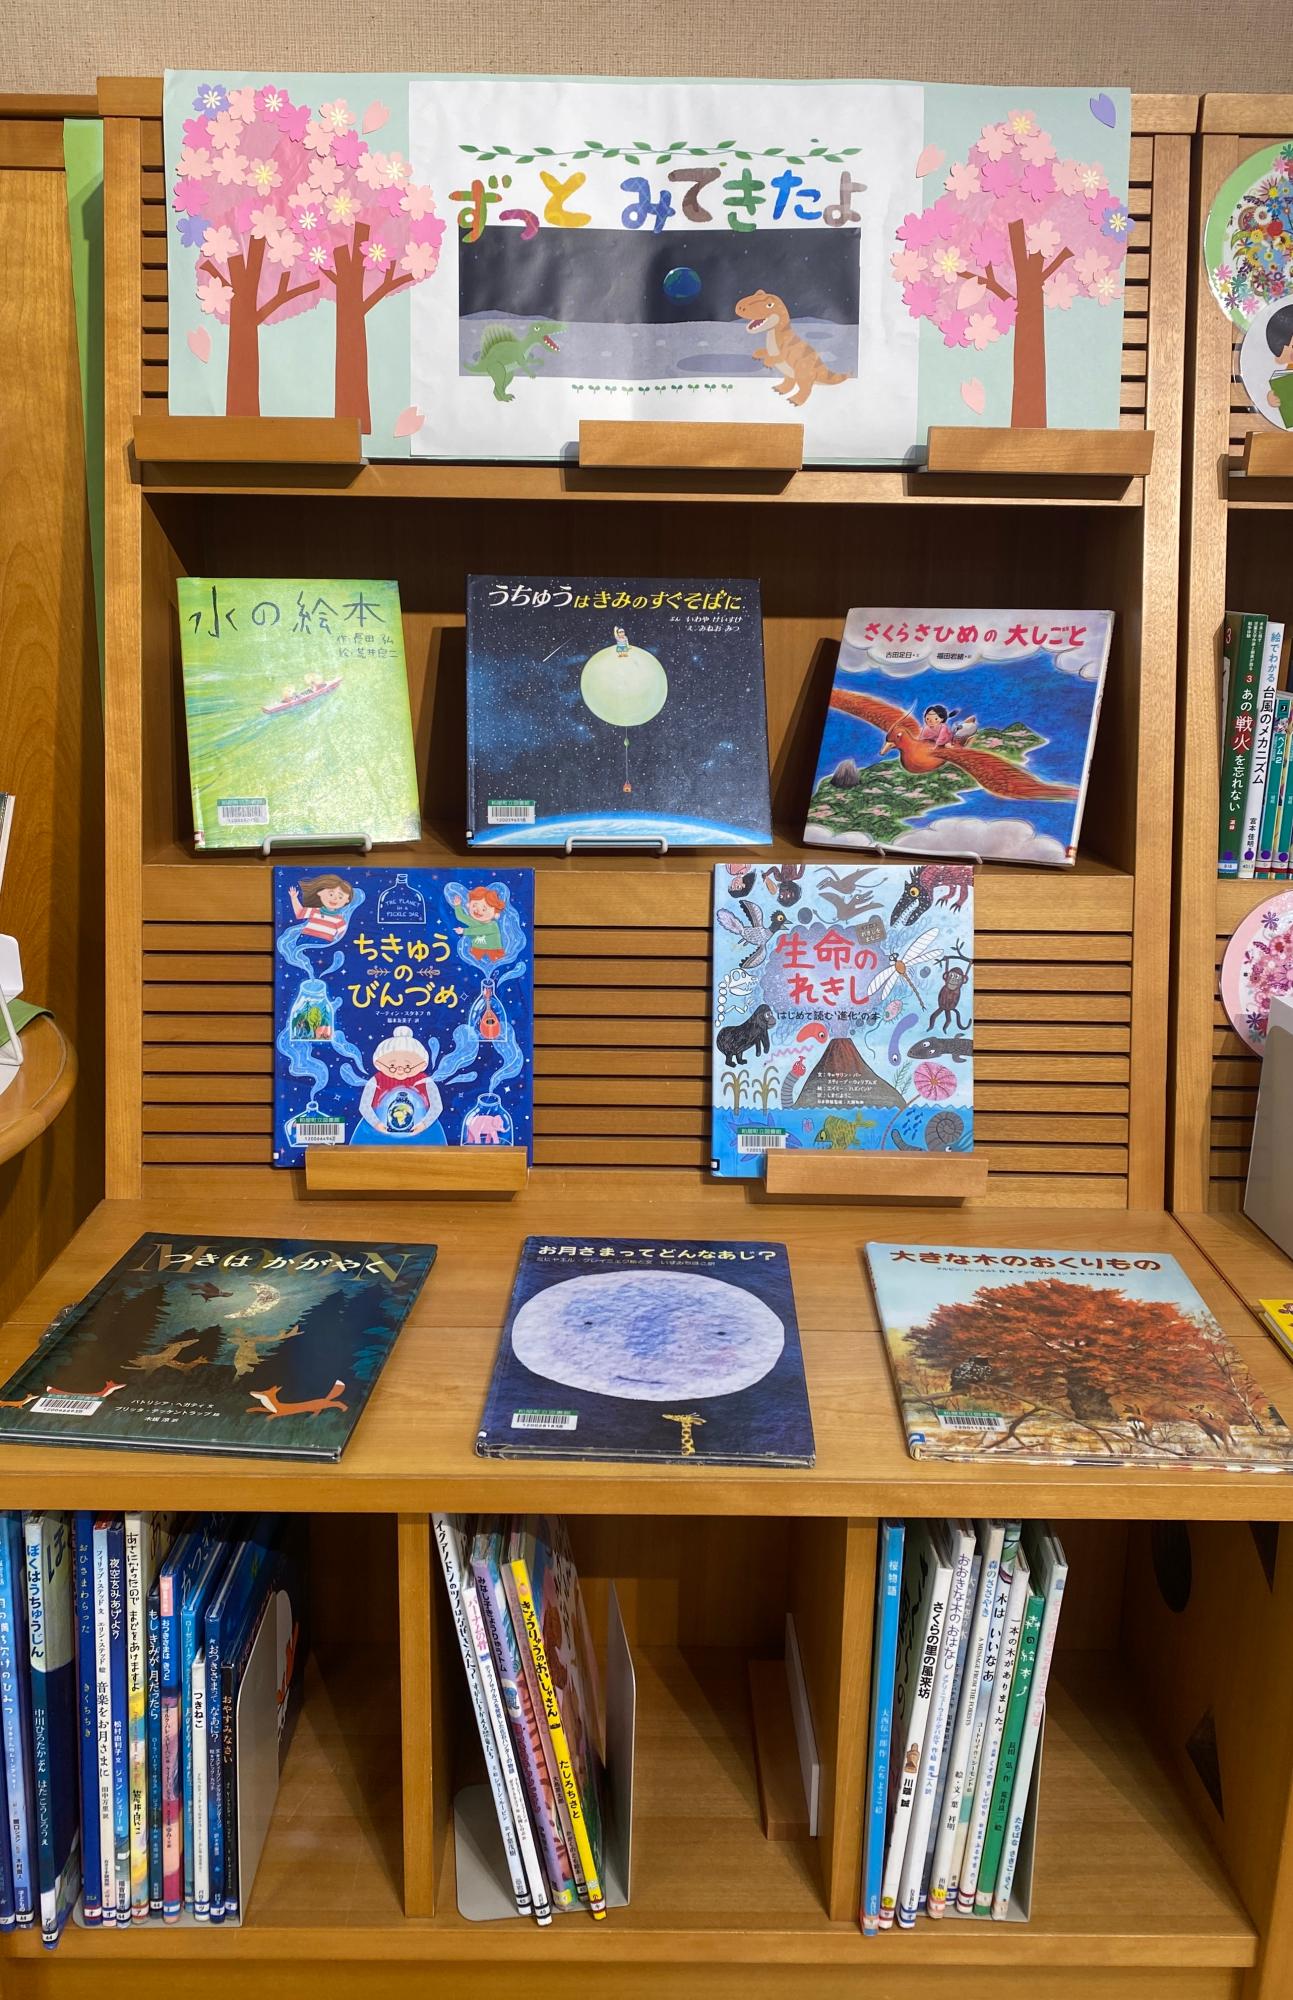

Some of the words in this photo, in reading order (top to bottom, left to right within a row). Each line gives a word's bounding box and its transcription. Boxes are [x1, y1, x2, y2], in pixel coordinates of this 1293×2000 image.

[448, 170, 592, 243] ずっと
[620, 166, 868, 234] みてきたよ
[188, 584, 387, 639] 水の絵本
[488, 583, 743, 611] うちゅうはきみのすぐそばに
[1229, 688, 1254, 813] あの戦火を忘れない
[353, 932, 451, 963] ちきゅう
[394, 965, 414, 982] の
[775, 928, 878, 971] 生命の
[347, 980, 459, 1009] びんづめ
[787, 972, 870, 1007] れきし
[164, 1252, 253, 1269] つきは
[263, 1255, 384, 1274] かがやく
[890, 1249, 1162, 1272] 大きな木のおくりもの
[26, 1543, 44, 1659] ぼくはうちゅうじん
[79, 1543, 90, 1634] おひさまわらった
[109, 1558, 122, 1640] 夜空をみあげよう
[981, 1559, 998, 1618] 森のささやき
[994, 1592, 1009, 1619] 木は
[149, 1608, 159, 1631] もし
[1019, 1614, 1042, 1680] 森の絵本
[128, 1610, 141, 1692] まどをあけますよ
[148, 1634, 161, 1667] きみが
[917, 1601, 944, 1700] さくらの里の風来坊
[982, 1627, 1003, 1683] いいなあ
[994, 1617, 1022, 1733] 一本の木がありました。
[83, 1682, 91, 1738] きくちちき
[149, 1668, 161, 1721] 月だったら
[193, 1692, 204, 1729] つきねこ
[520, 1599, 559, 1719] きょうりゅうのおいしゃさん
[558, 1760, 582, 1819] たしろちさと
[34, 1708, 47, 1759] 中川ひろたか
[96, 1680, 110, 1778] 音楽をお月さまに
[222, 1695, 234, 1764] おやすみなさい
